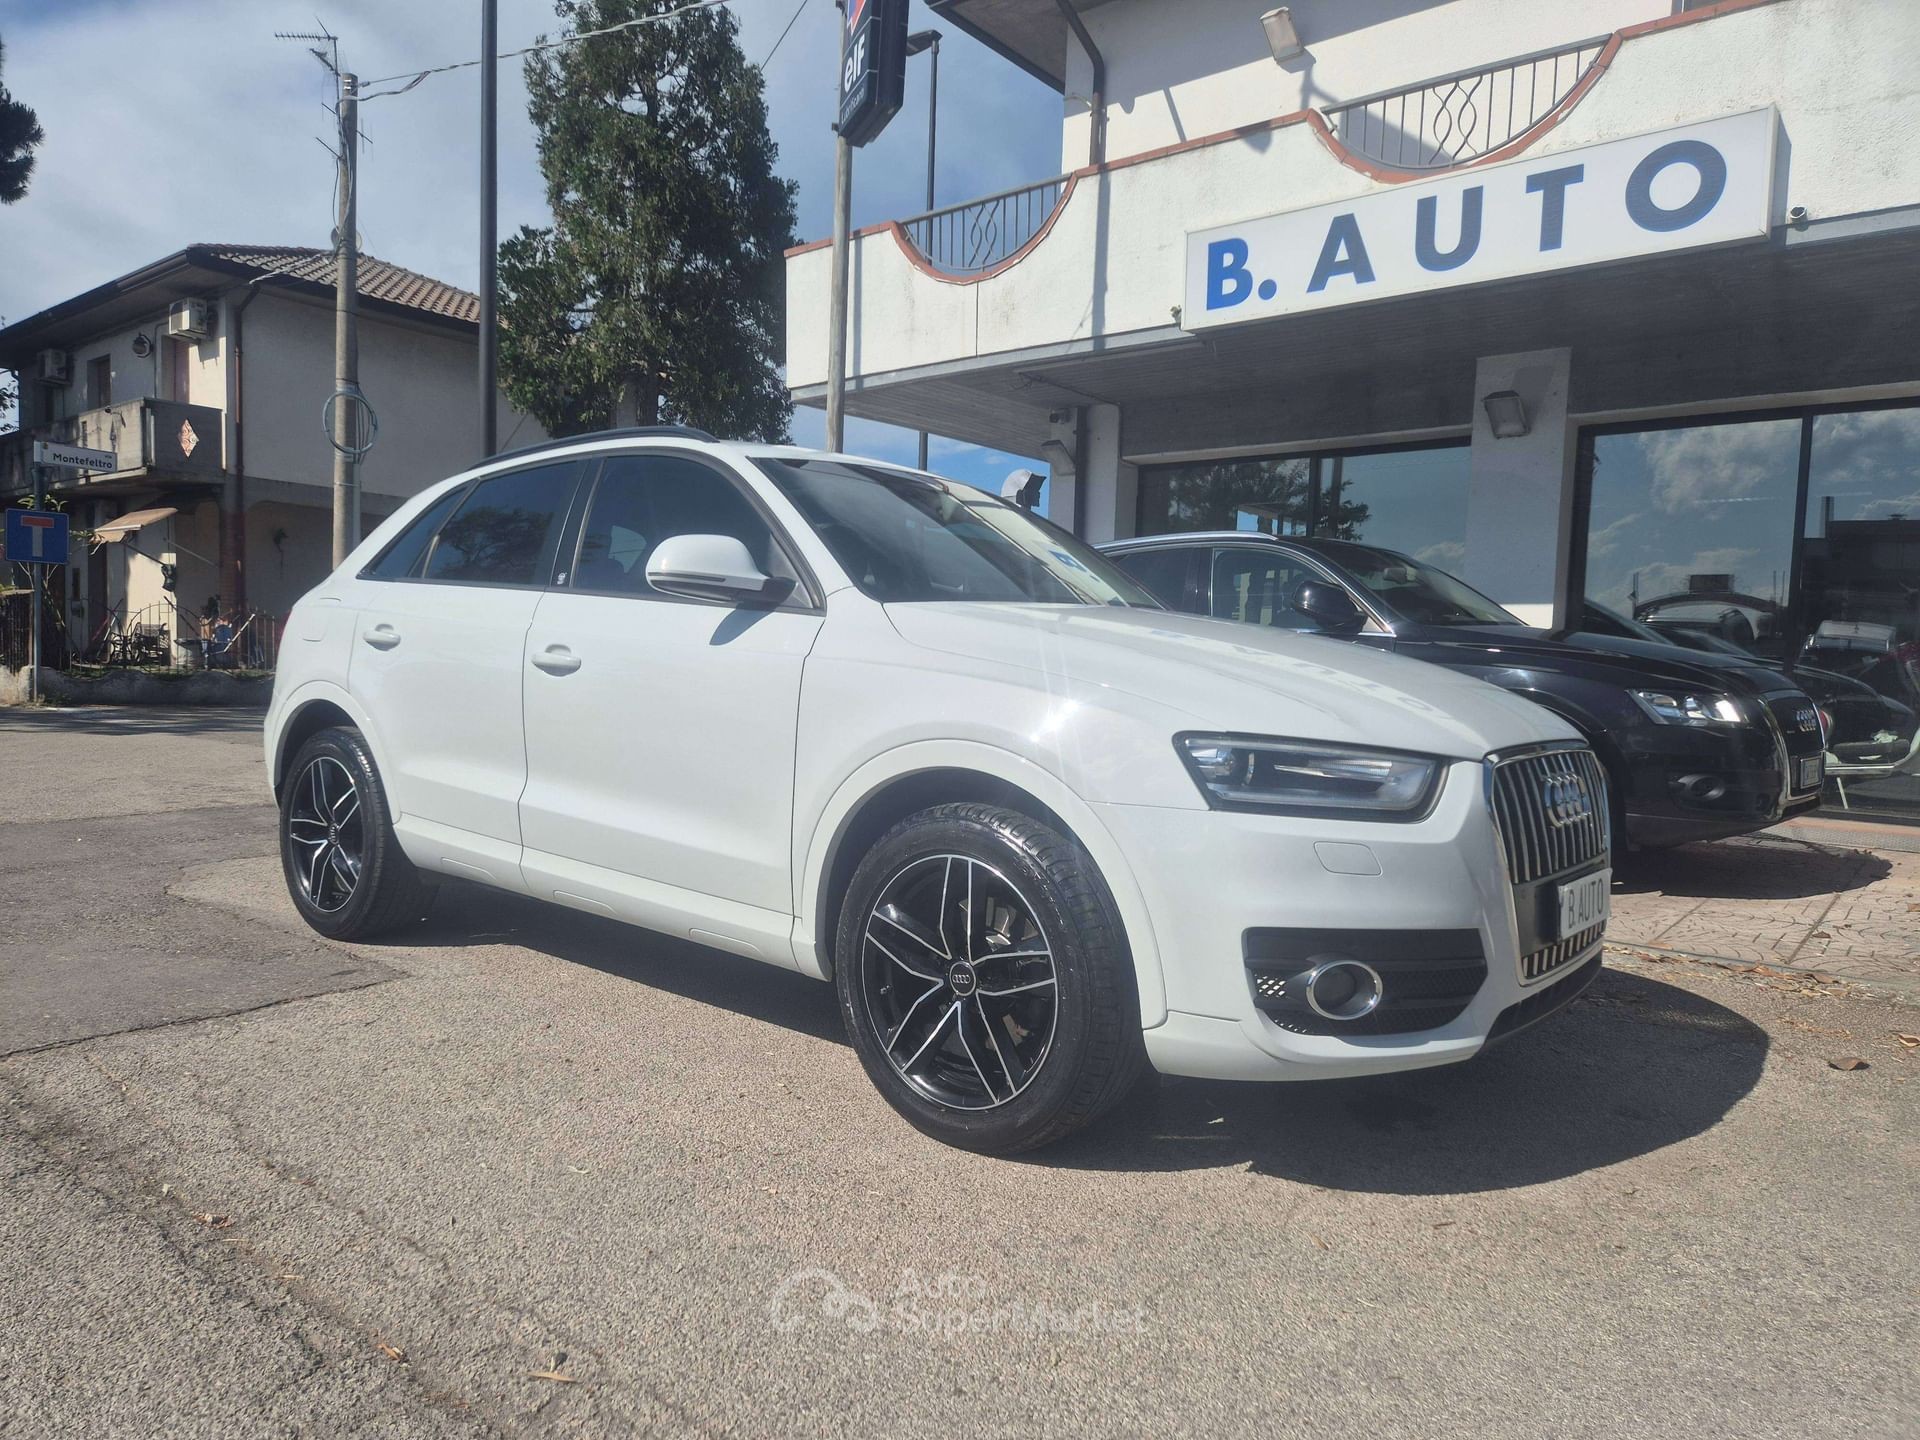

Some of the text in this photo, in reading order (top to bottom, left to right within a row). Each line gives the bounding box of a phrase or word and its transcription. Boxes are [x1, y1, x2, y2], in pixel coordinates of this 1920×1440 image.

[844, 33, 865, 92] elf
[1206, 139, 1727, 311] B. AUTO
[53, 453, 112, 469] Montefeltro
[1579, 879, 1603, 922] AUTO
